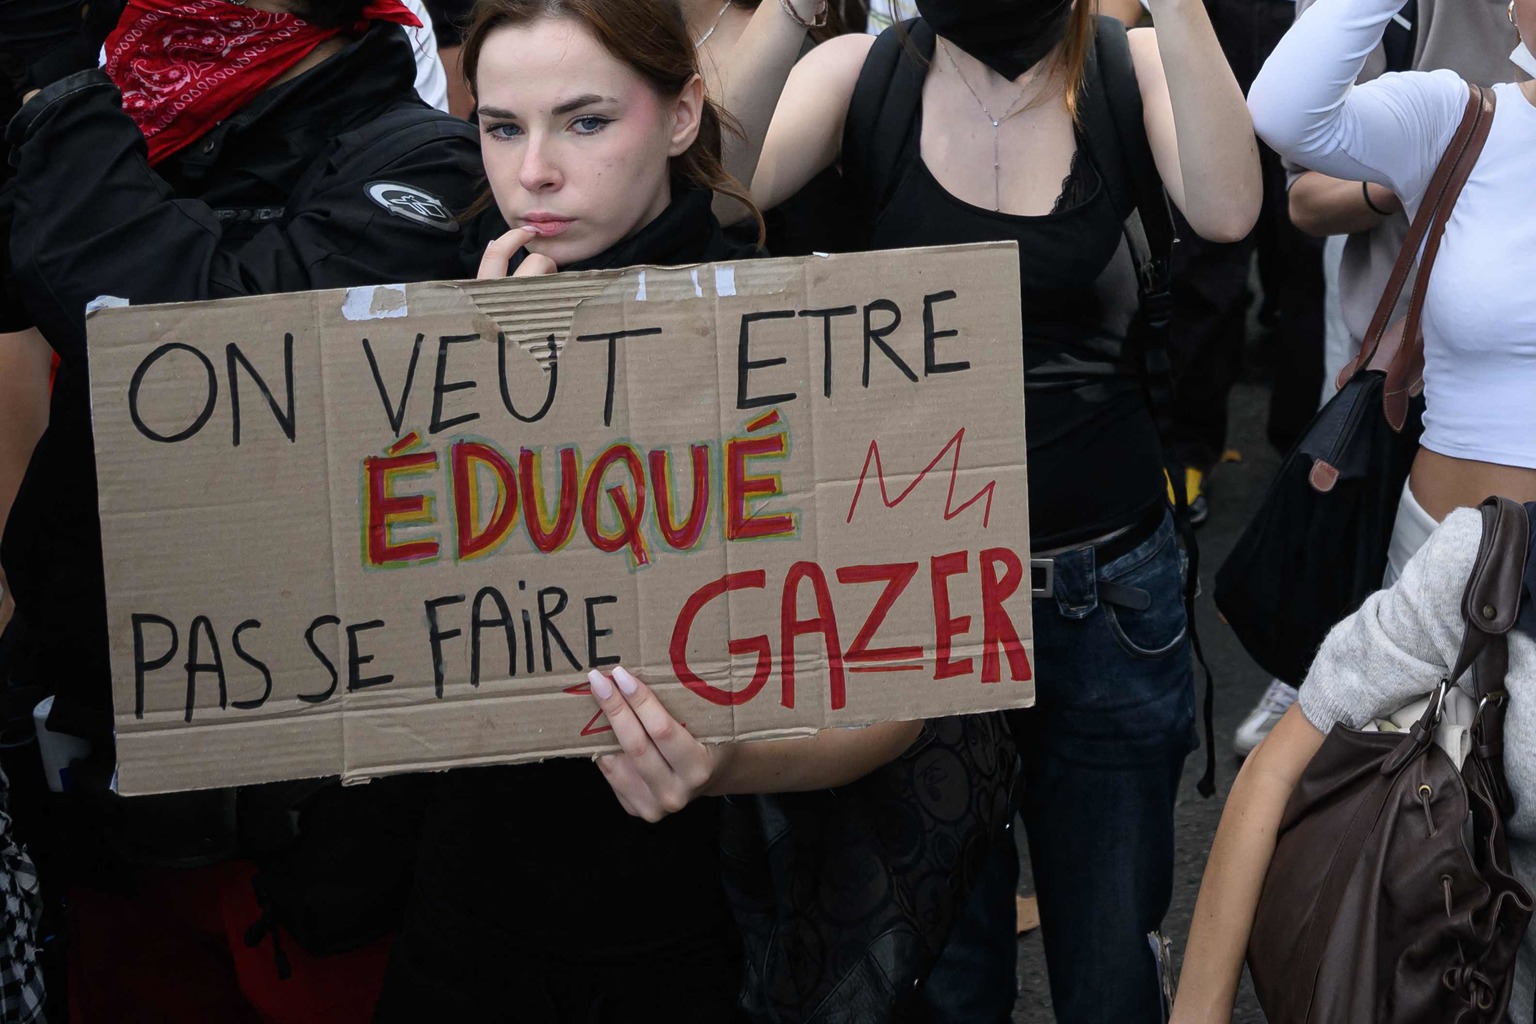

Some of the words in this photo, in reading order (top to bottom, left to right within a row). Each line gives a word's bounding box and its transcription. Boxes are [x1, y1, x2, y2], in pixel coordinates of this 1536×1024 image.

[127, 333, 297, 447] ON
[362, 325, 664, 439] VEUT
[737, 289, 972, 410] ETRE
[362, 408, 802, 571] ÉDUQUÉ
[131, 612, 273, 723] PAS
[297, 614, 394, 703] SE
[669, 547, 1033, 711] GAZER
